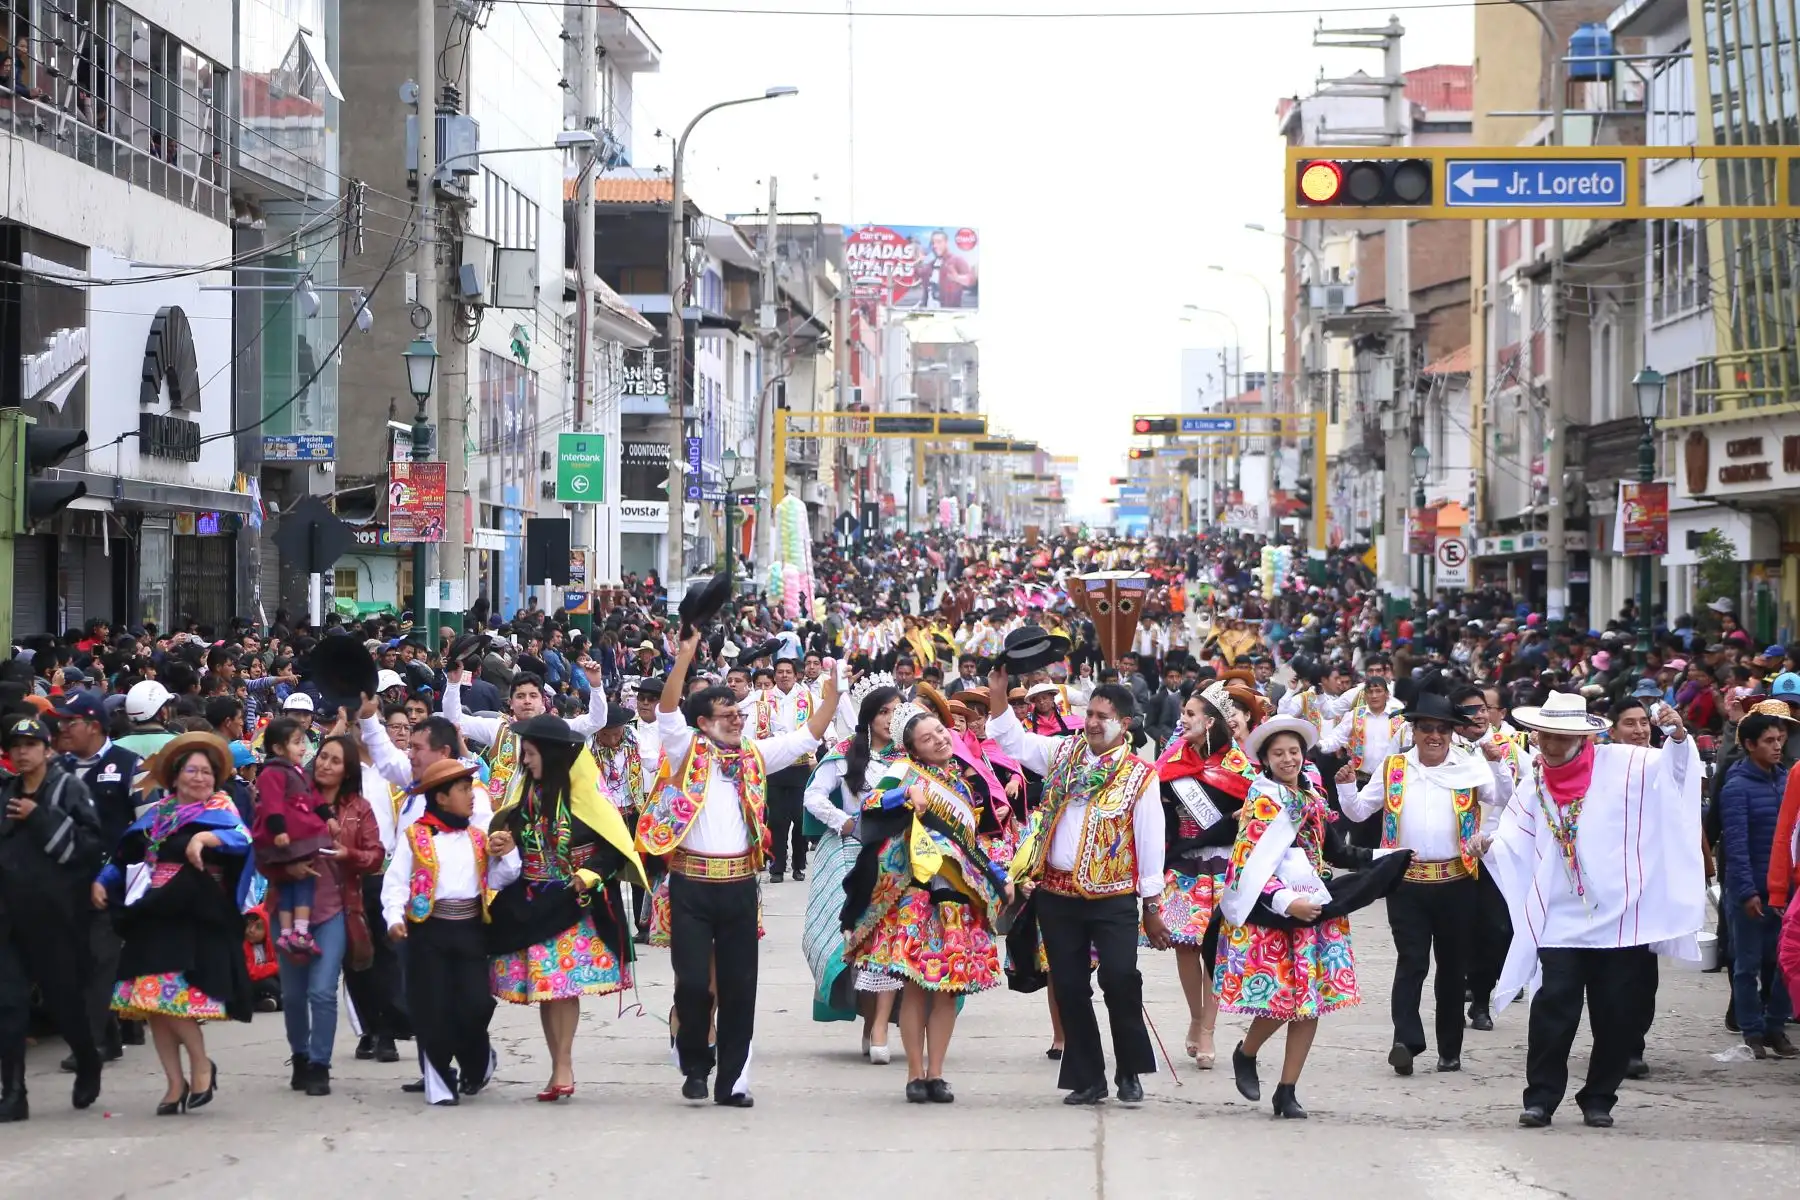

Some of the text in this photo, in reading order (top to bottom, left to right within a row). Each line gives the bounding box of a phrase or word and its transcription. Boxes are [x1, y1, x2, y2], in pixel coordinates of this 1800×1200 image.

[1506, 171, 1614, 195] Jr. Loreto
[561, 453, 600, 462] Interbank
[1193, 798, 1215, 823] MISS
